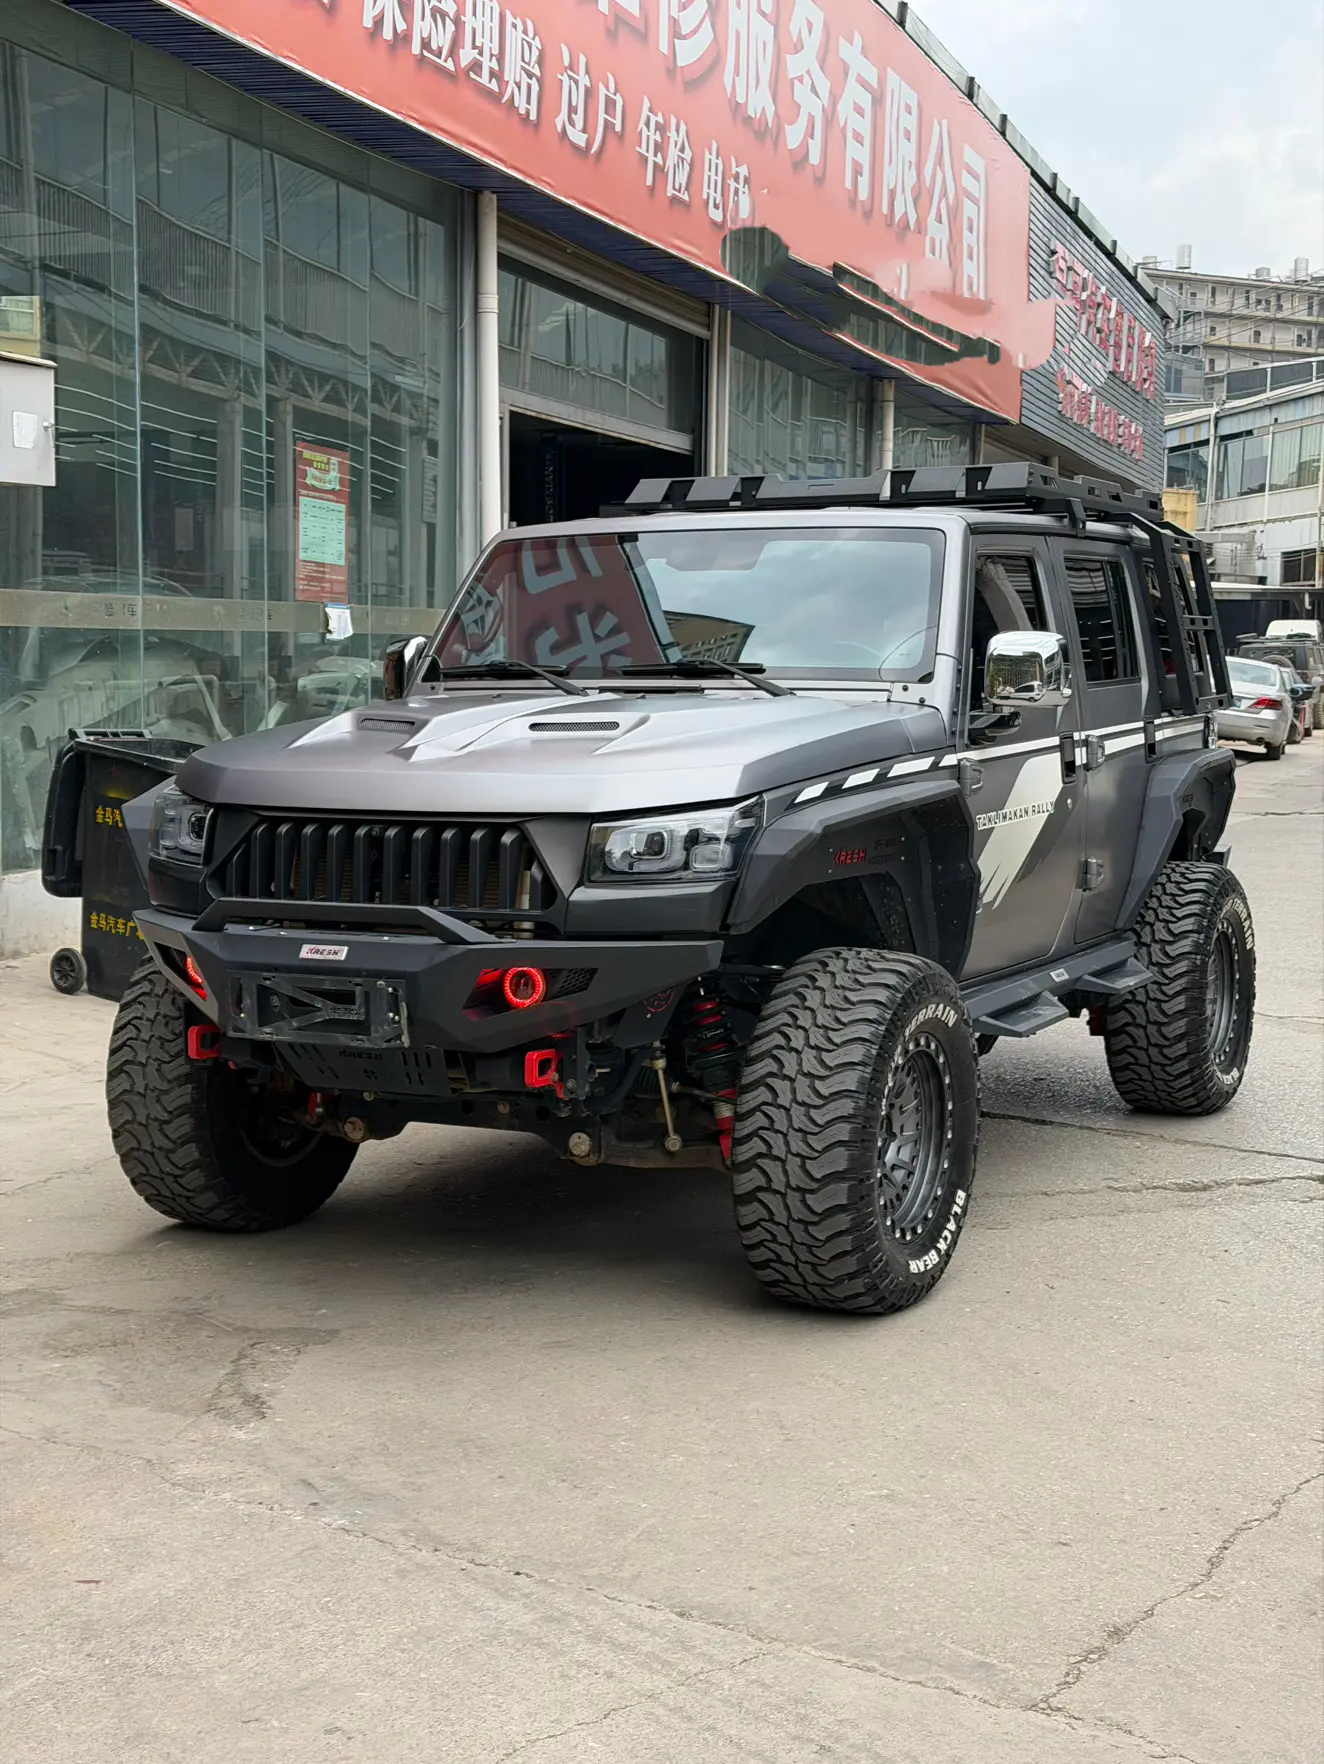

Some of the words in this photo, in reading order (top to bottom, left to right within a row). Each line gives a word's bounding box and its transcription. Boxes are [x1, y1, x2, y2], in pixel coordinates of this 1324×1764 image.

[557, 43, 624, 154] 过户
[636, 95, 692, 203] 年检
[977, 807, 1030, 829] TAKLIMAKAN
[1031, 800, 1056, 816] RALLY
[306, 947, 341, 956] KRESH
[904, 1003, 958, 1041] TERRAIN
[936, 1189, 967, 1256] BLACK
[908, 1249, 940, 1274] BEAR
